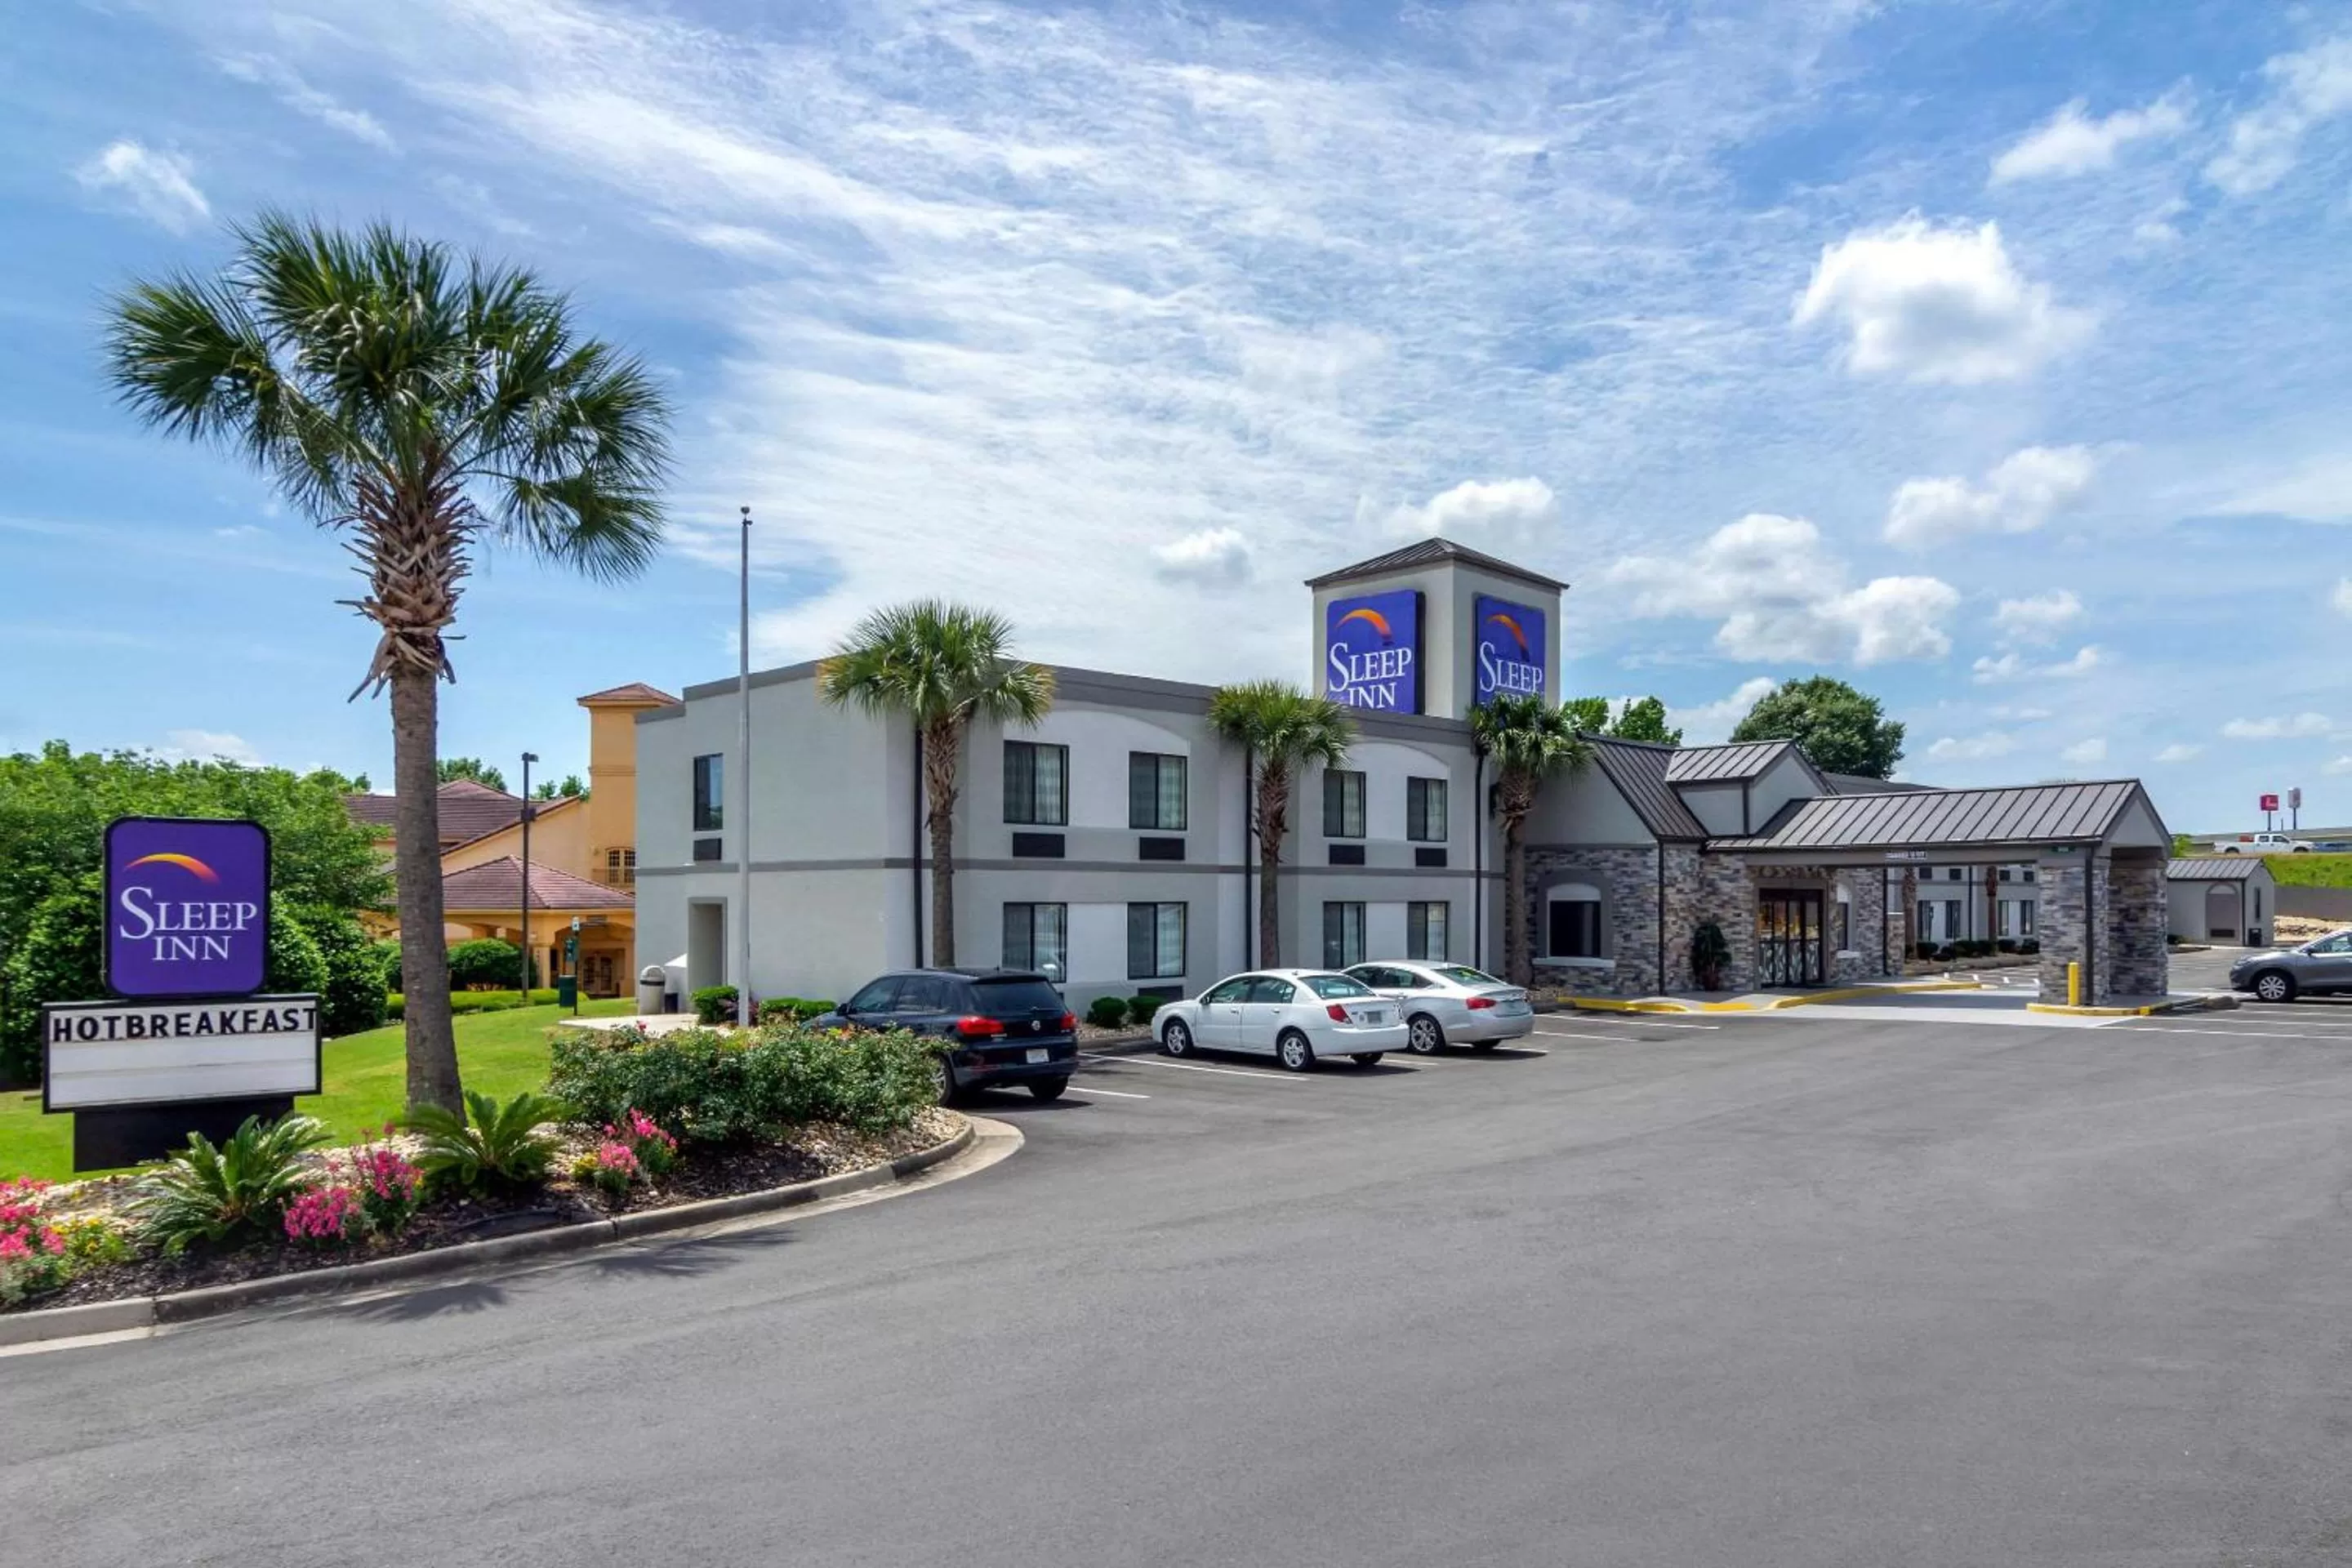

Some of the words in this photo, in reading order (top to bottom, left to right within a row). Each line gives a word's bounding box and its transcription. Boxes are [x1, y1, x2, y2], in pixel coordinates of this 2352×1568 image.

[1329, 642, 1412, 693] SLEEP
[1480, 641, 1543, 693] SLEEP
[1347, 682, 1397, 709] INN
[119, 887, 257, 939] SLEEP
[152, 936, 232, 961] INN
